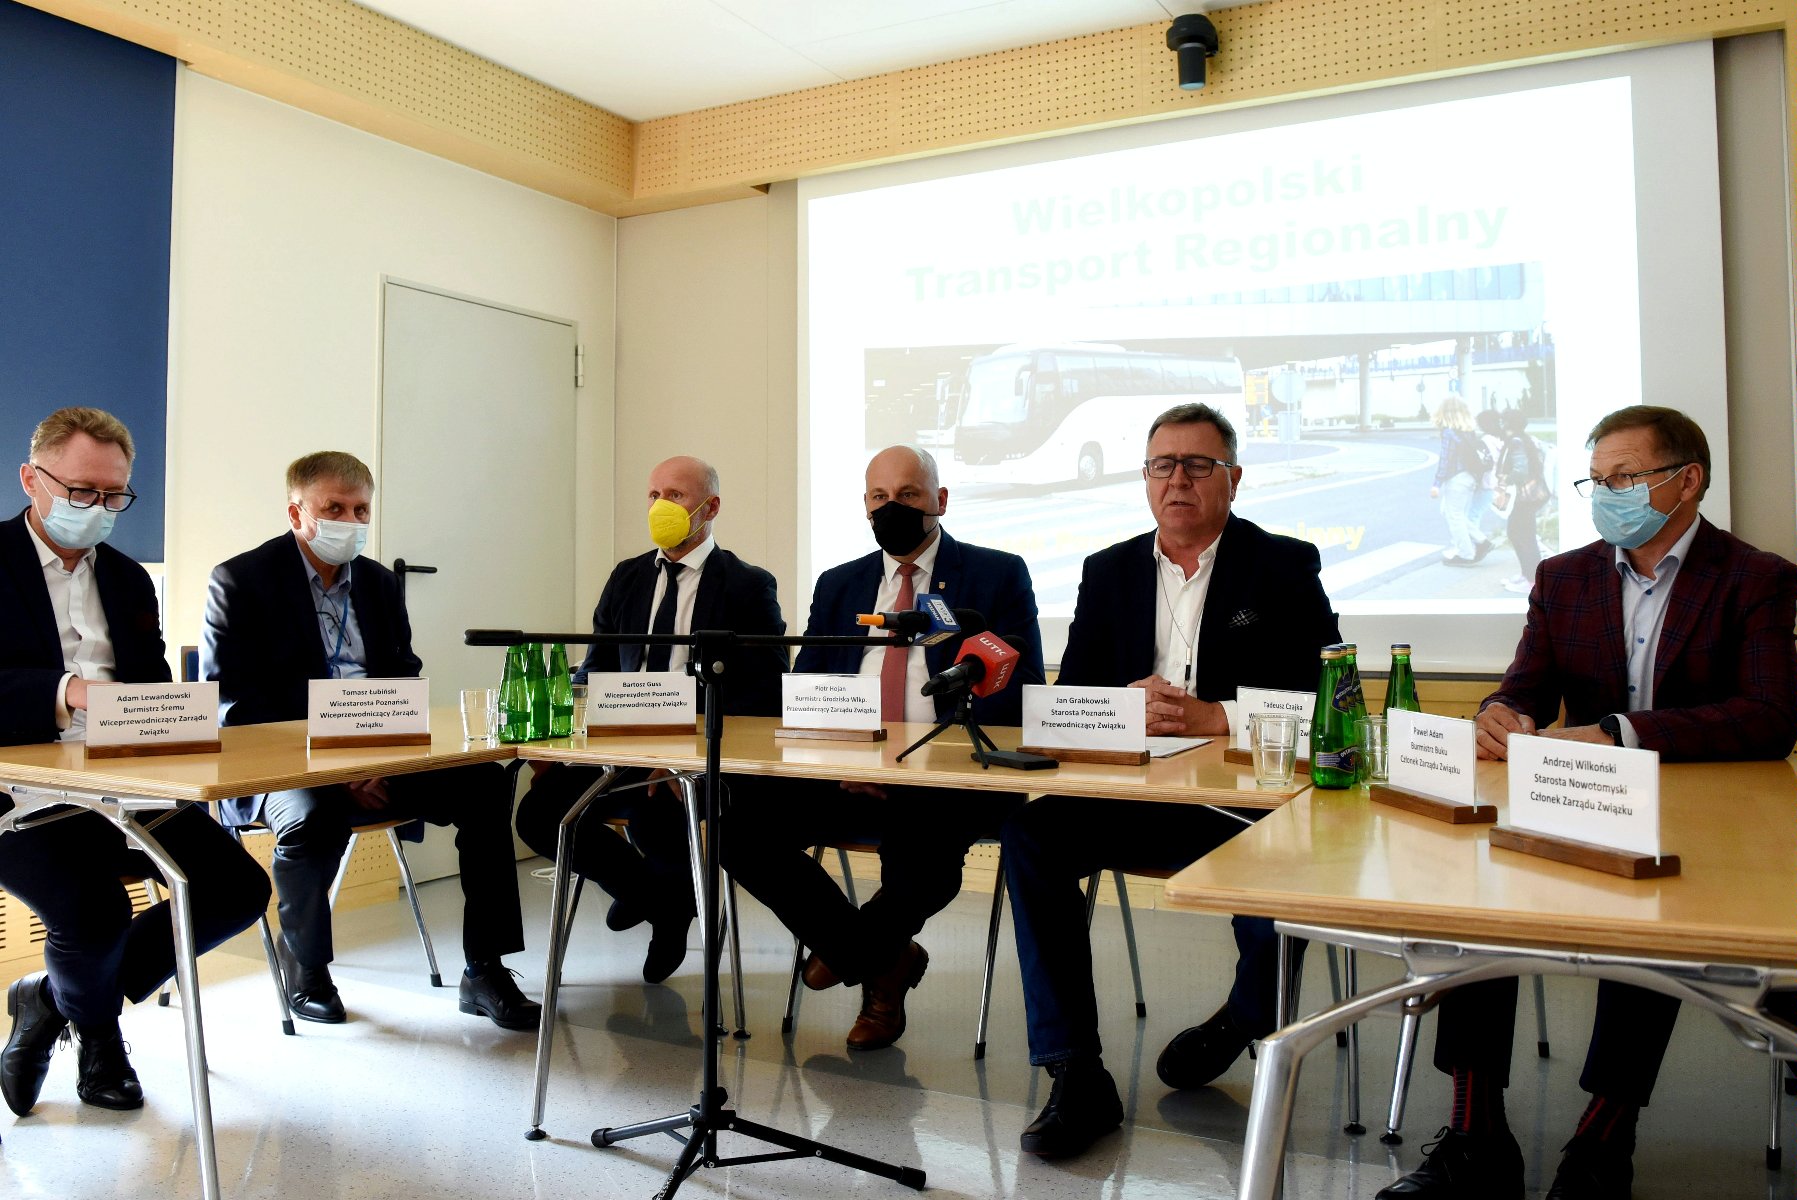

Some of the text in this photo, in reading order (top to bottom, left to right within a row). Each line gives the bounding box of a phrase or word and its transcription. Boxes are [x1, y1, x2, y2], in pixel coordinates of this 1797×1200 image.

[1011, 154, 1363, 235] Wielkopolski
[905, 204, 1508, 303] Transport Regionalny
[117, 692, 191, 702] Adam Lewandowski
[604, 691, 650, 699] Wiceprezydent
[375, 698, 409, 706] Poznański
[597, 701, 661, 709] Wiceprzewodniczący
[1069, 697, 1110, 705] Grabkowski
[1263, 701, 1285, 710] Tadeusz
[123, 704, 185, 714] Burmistrz Śremu
[320, 709, 419, 719] Wiceprzewodniczący Zarządu
[1081, 709, 1116, 717] Poznański
[99, 714, 208, 727] Wiceprzewodniczący Zarządu
[355, 721, 383, 729] Związku
[1041, 720, 1126, 731] Przewodniczący Związku
[139, 728, 170, 737] Związku
[1429, 729, 1444, 739] Adam
[1410, 741, 1448, 756] Burmistrz Buku
[1400, 754, 1461, 774] Członek Zarządu Związku
[1542, 756, 1617, 774] Andrzej Wilkoński
[1534, 773, 1628, 796] Starosta Nowotomyski
[1530, 791, 1633, 816] Członek Zarządu Związku
